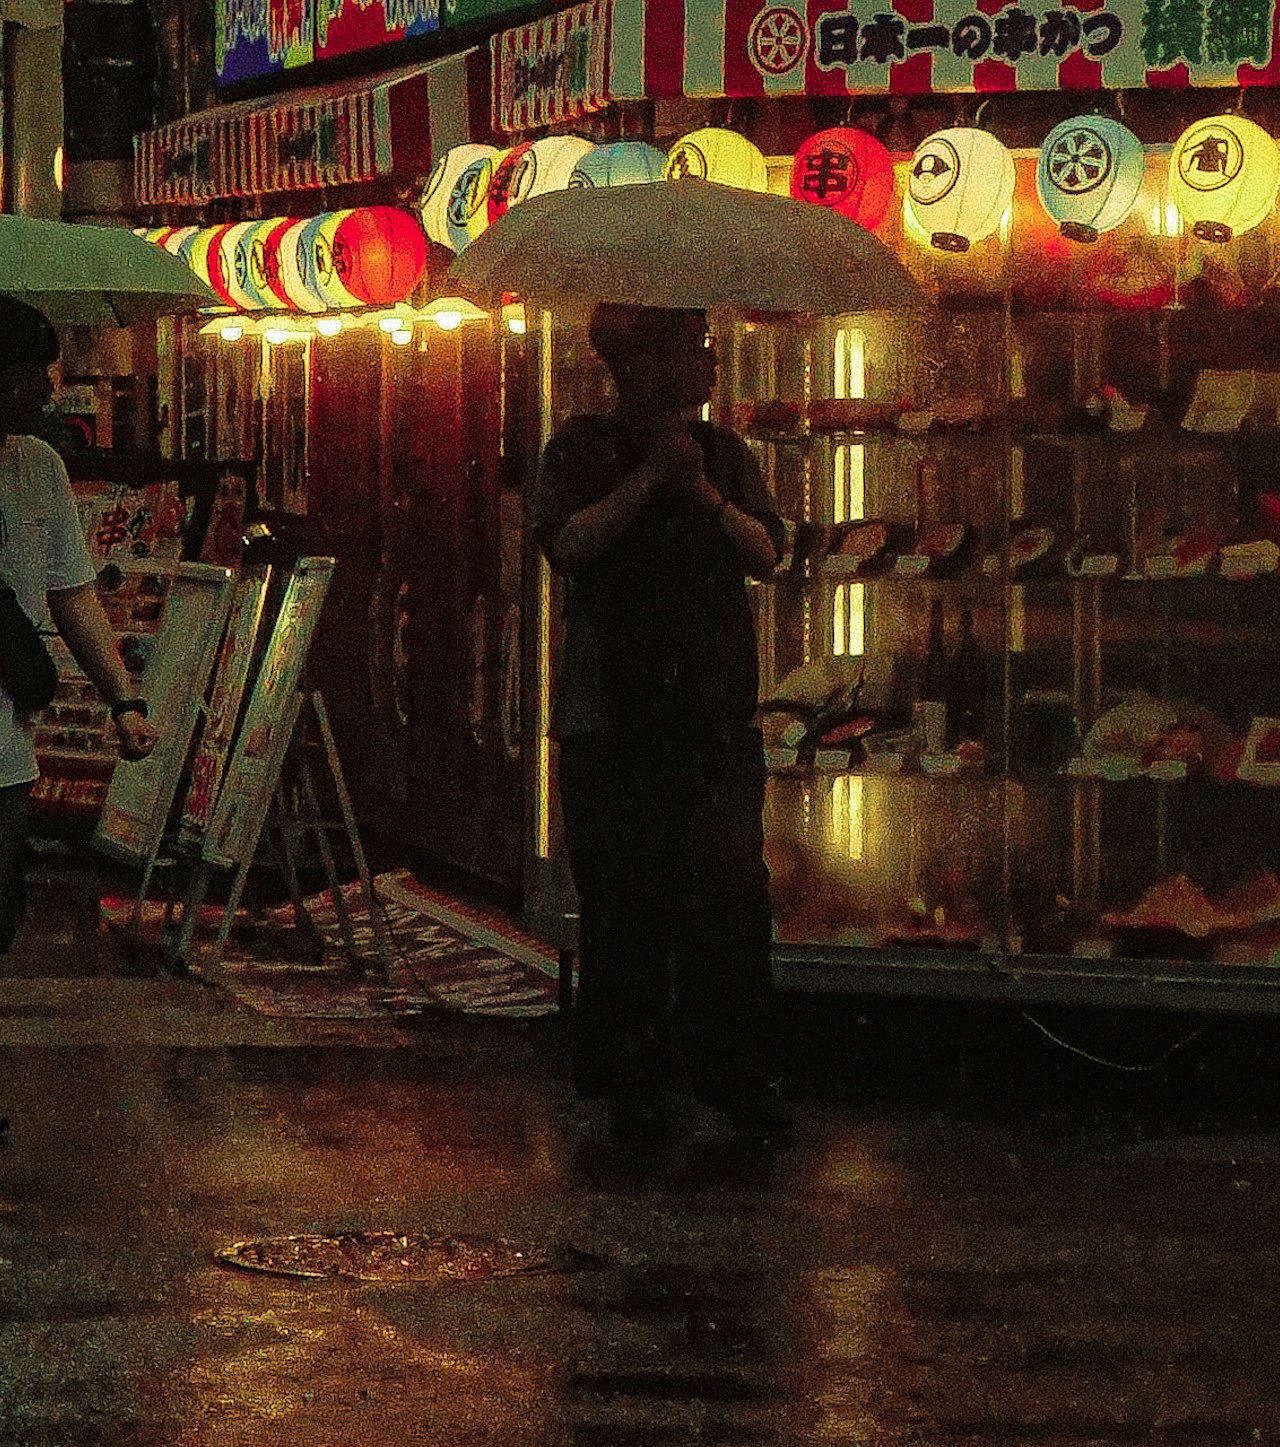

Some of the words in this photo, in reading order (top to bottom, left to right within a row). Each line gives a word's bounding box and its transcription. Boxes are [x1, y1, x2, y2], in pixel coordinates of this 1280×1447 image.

[818, 8, 1122, 65] 日本一の串かつ
